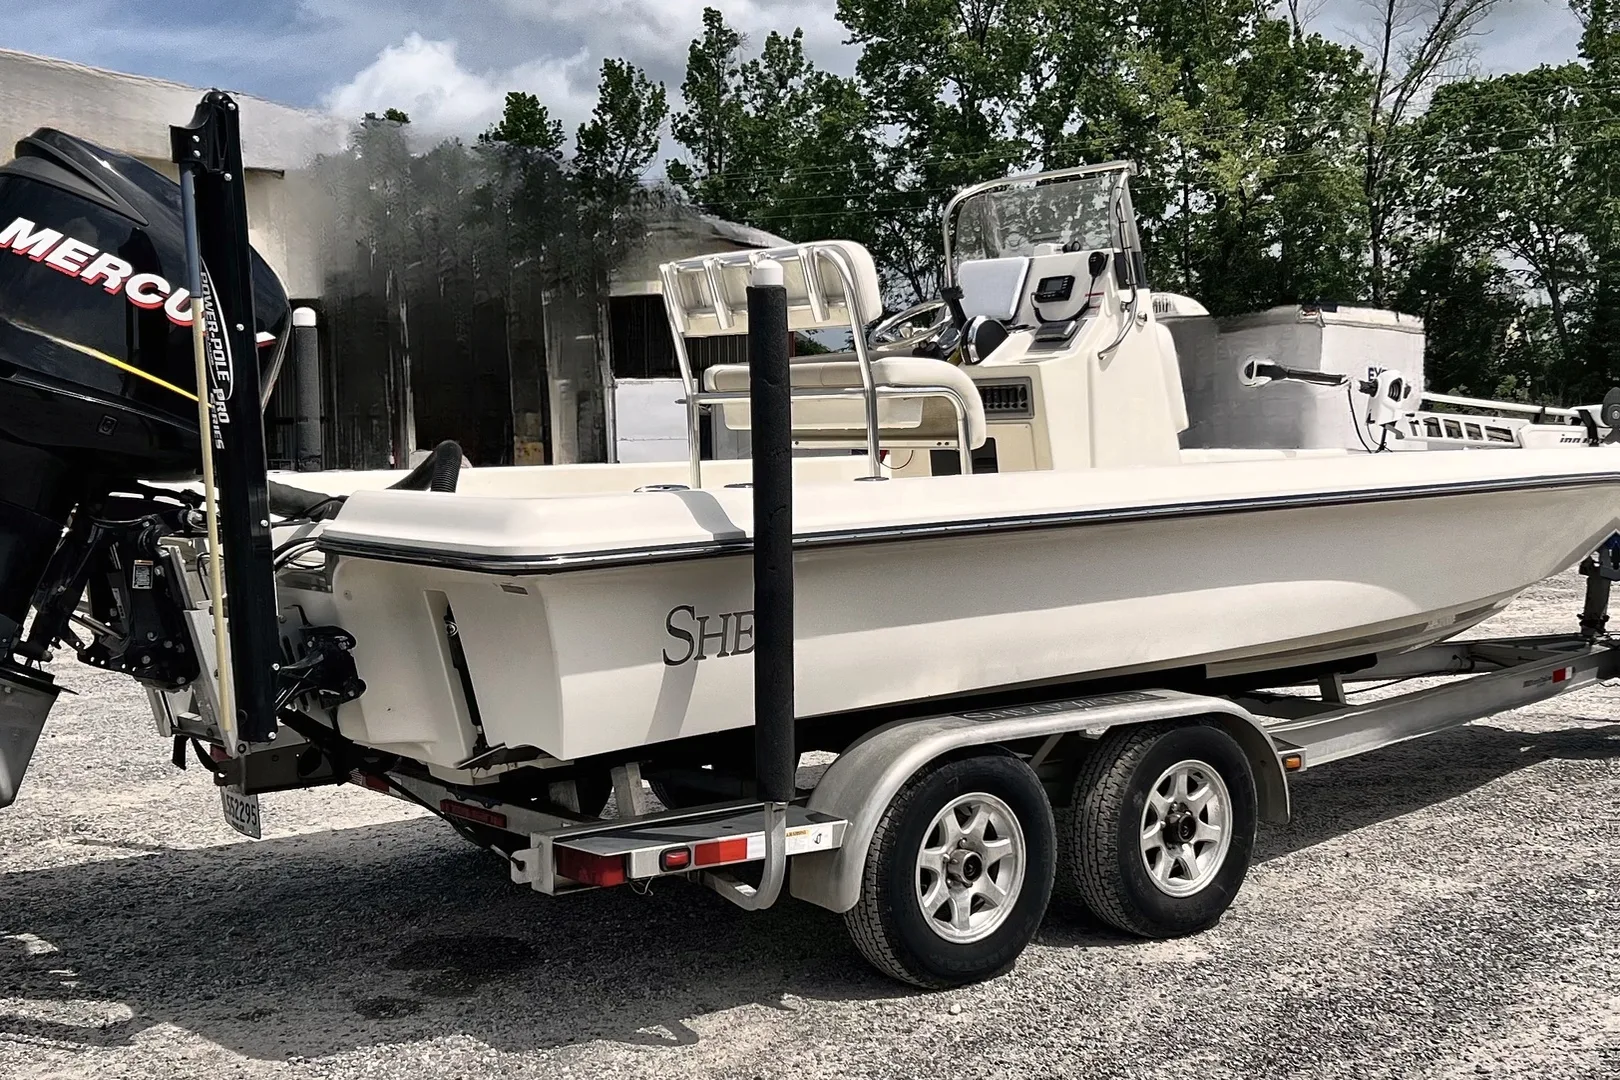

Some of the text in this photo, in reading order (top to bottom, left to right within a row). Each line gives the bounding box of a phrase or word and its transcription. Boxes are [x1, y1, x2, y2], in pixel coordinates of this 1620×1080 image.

[0, 217, 276, 346] MERCU
[200, 271, 230, 382] POWER-POLE
[212, 388, 230, 423] PRO
